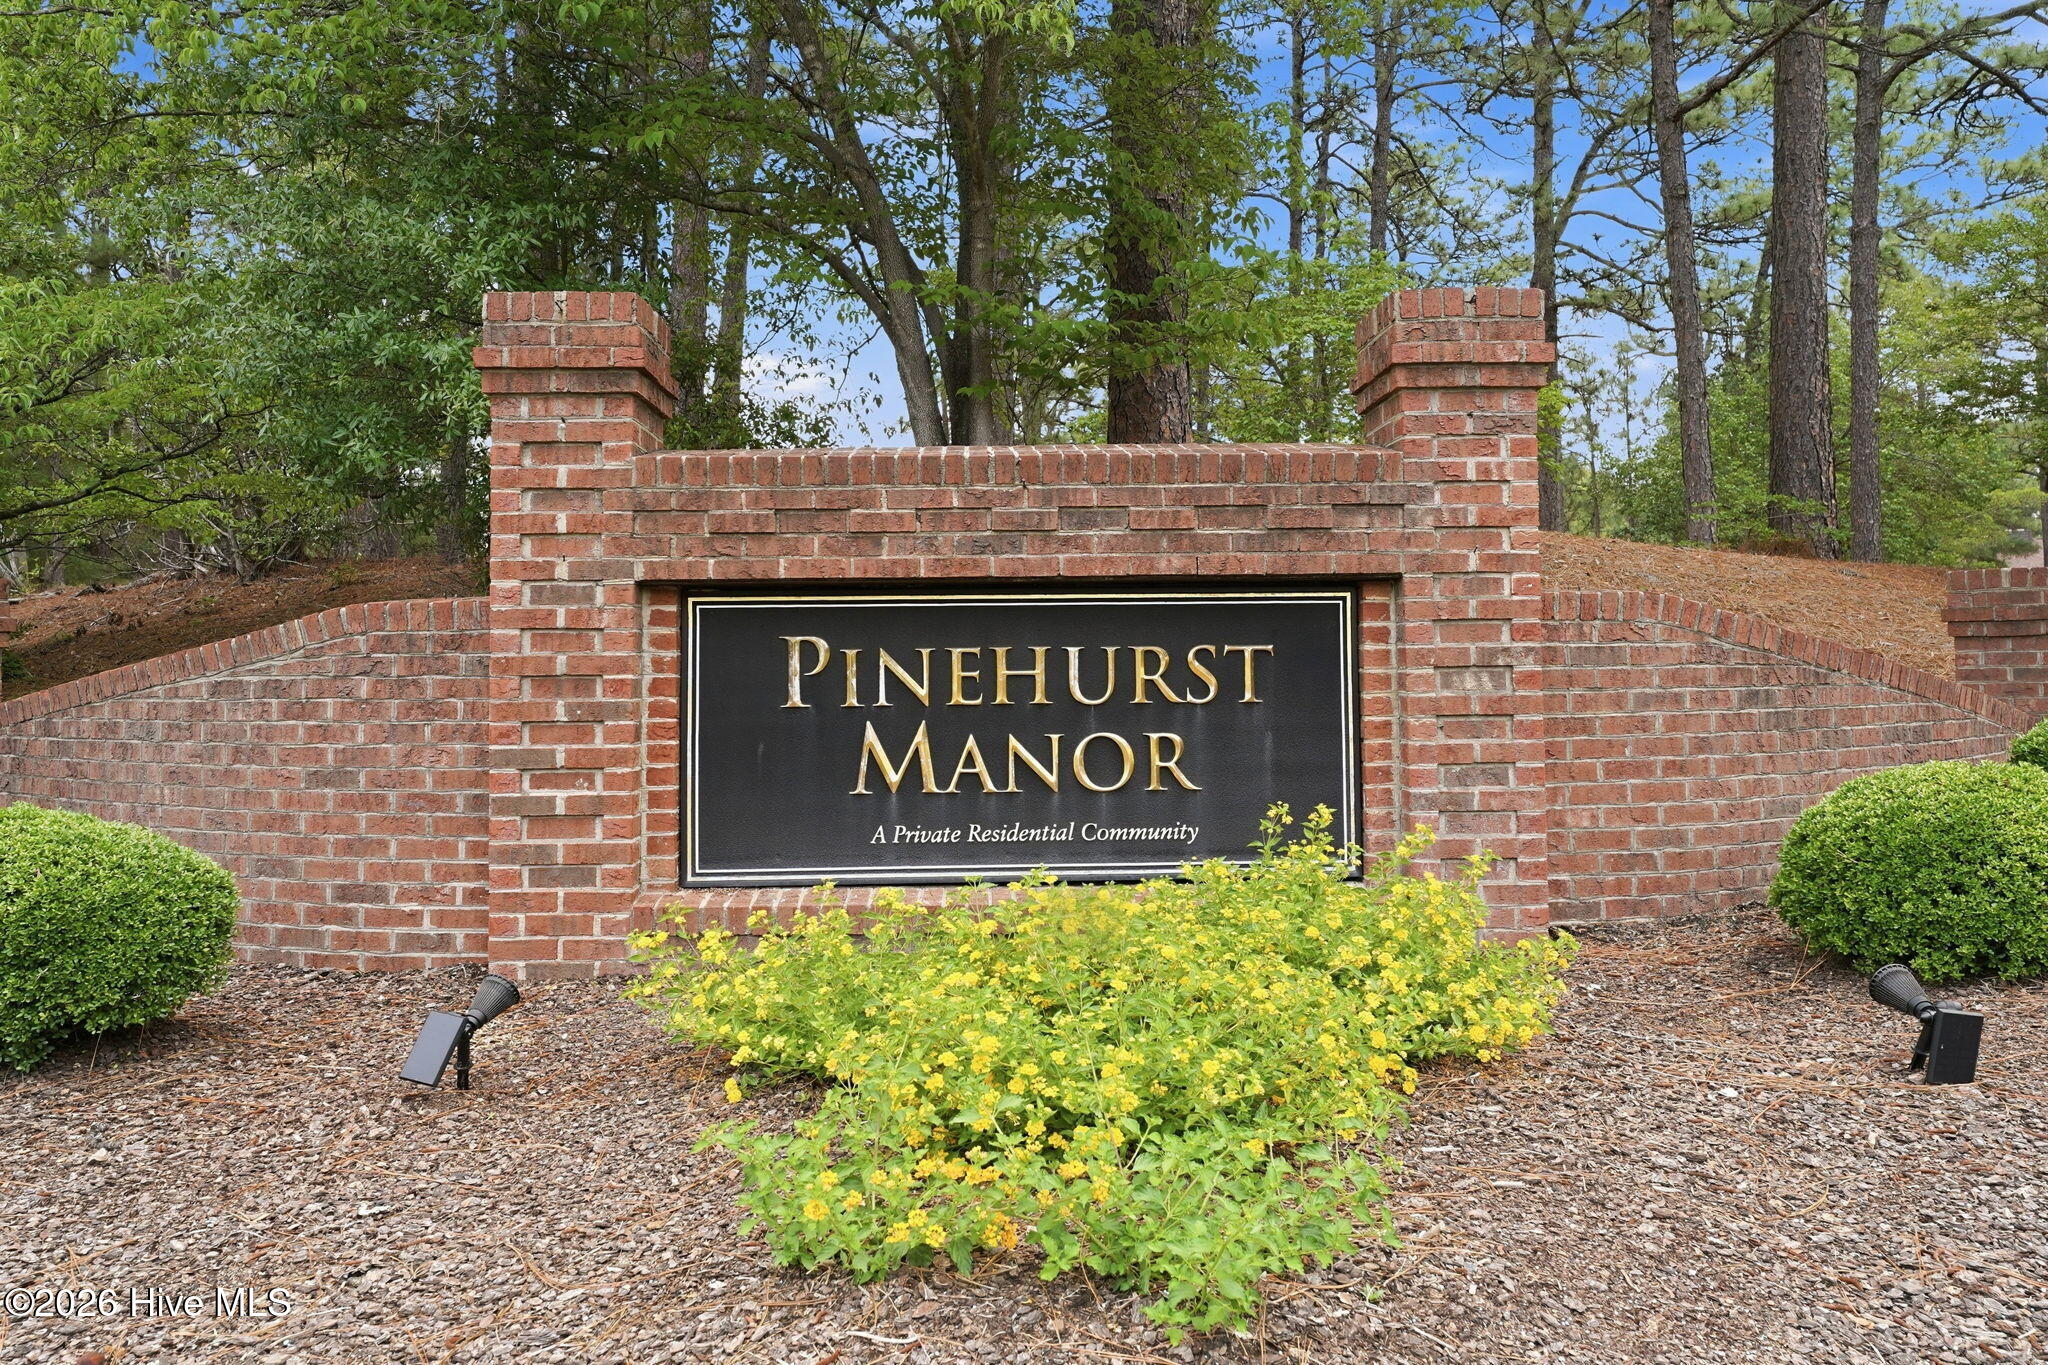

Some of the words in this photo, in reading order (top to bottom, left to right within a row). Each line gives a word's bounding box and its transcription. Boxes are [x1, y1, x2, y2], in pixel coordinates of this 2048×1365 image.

[778, 635, 1274, 708] PINEHURST
[848, 720, 1202, 795] MANOR
[870, 825, 886, 843] A
[892, 824, 961, 843] Private
[967, 822, 1074, 842] Residential
[1081, 821, 1199, 844] Community
